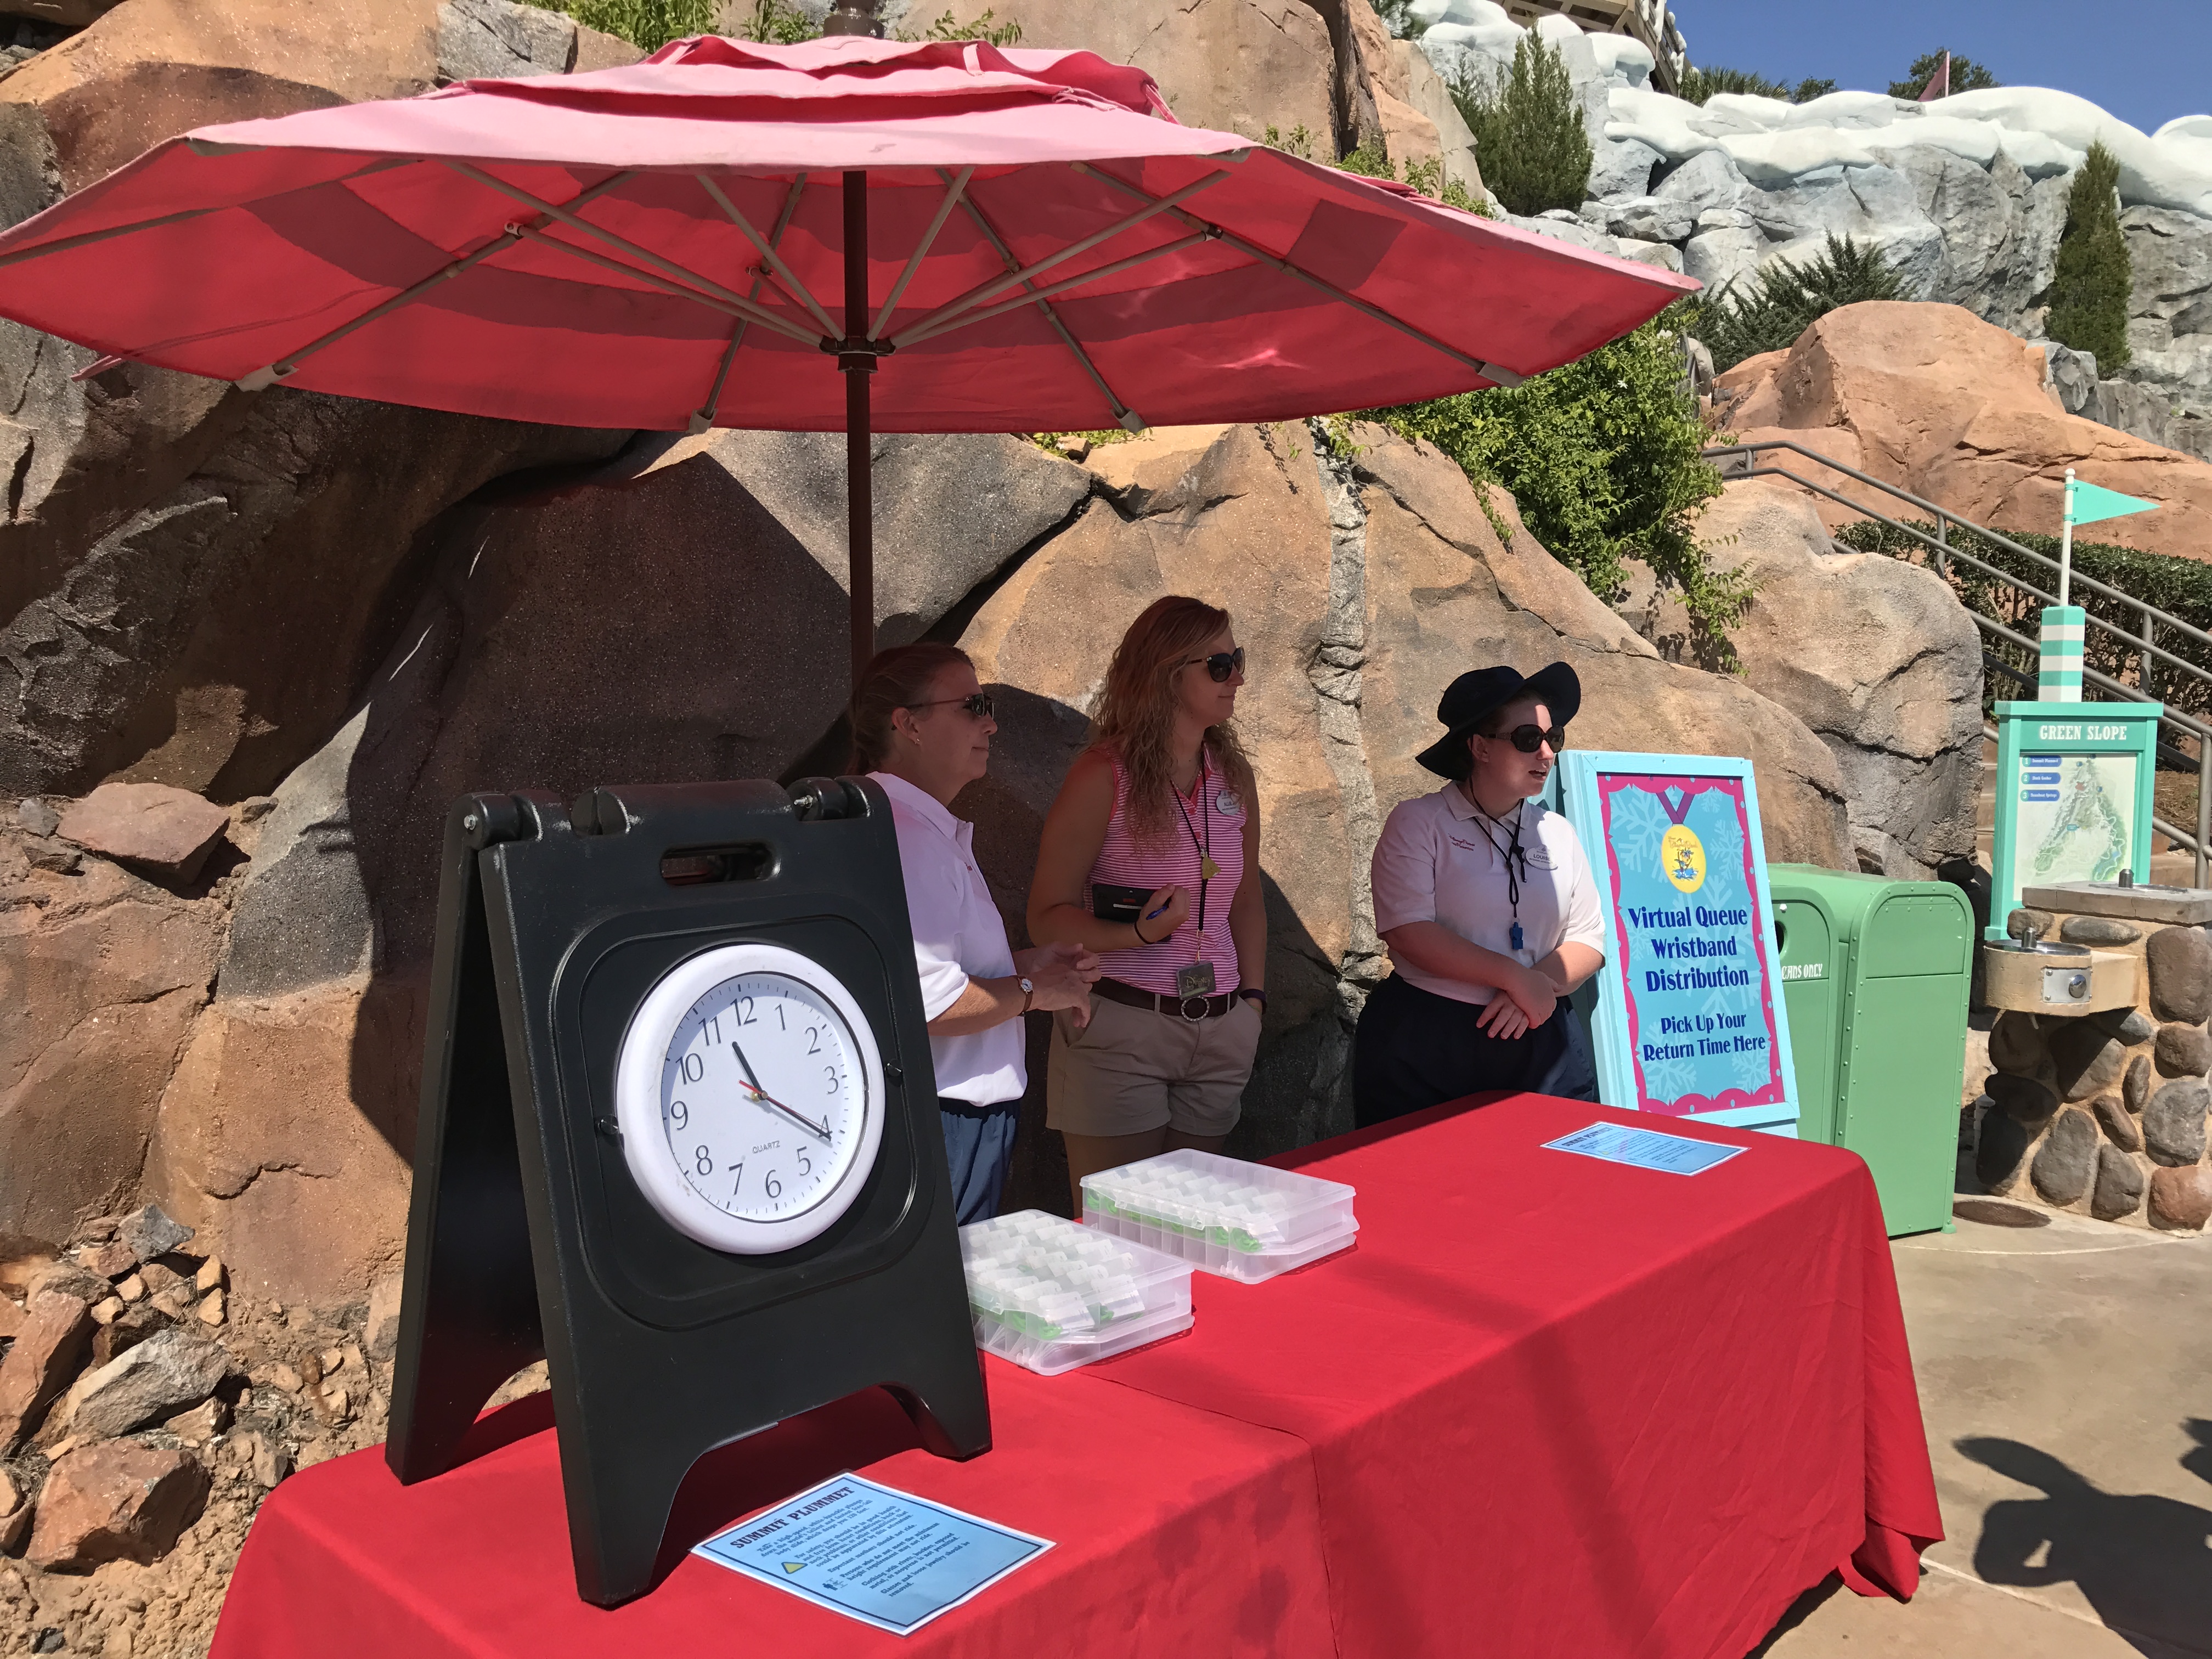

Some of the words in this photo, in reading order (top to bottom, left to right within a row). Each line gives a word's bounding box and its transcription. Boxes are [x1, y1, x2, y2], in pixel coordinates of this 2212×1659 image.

[2039, 725, 2081, 740] GREEN
[2086, 725, 2128, 740] SLOPE
[1627, 906, 1692, 929] Virtual
[1695, 906, 1748, 928] Queue
[1650, 935, 1737, 960] Wristband
[1645, 964, 1750, 992] Distribution
[1781, 964, 1802, 980] CANS
[1803, 963, 1823, 978] ONLY
[730, 996, 758, 1027] 12
[774, 1003, 786, 1031] 1
[1661, 1015, 1694, 1035] Pick
[1696, 1014, 1714, 1034] Up
[1716, 1013, 1747, 1029] Your
[698, 1015, 722, 1046] 11
[803, 1026, 821, 1056] 2
[1643, 1042, 1695, 1062] Return
[1697, 1037, 1731, 1056] Time
[1734, 1035, 1766, 1052] Here
[675, 1052, 704, 1086] 10
[822, 1065, 839, 1095] 3
[670, 1100, 689, 1131] 9
[819, 1114, 833, 1138] 4
[693, 1144, 713, 1176] 8
[752, 1140, 781, 1154] QUARTZ
[795, 1146, 812, 1176] 5
[728, 1162, 744, 1196] 7
[764, 1169, 782, 1198] 6
[730, 1519, 790, 1549] SUMMIT
[786, 1486, 855, 1521] PLUMMET
